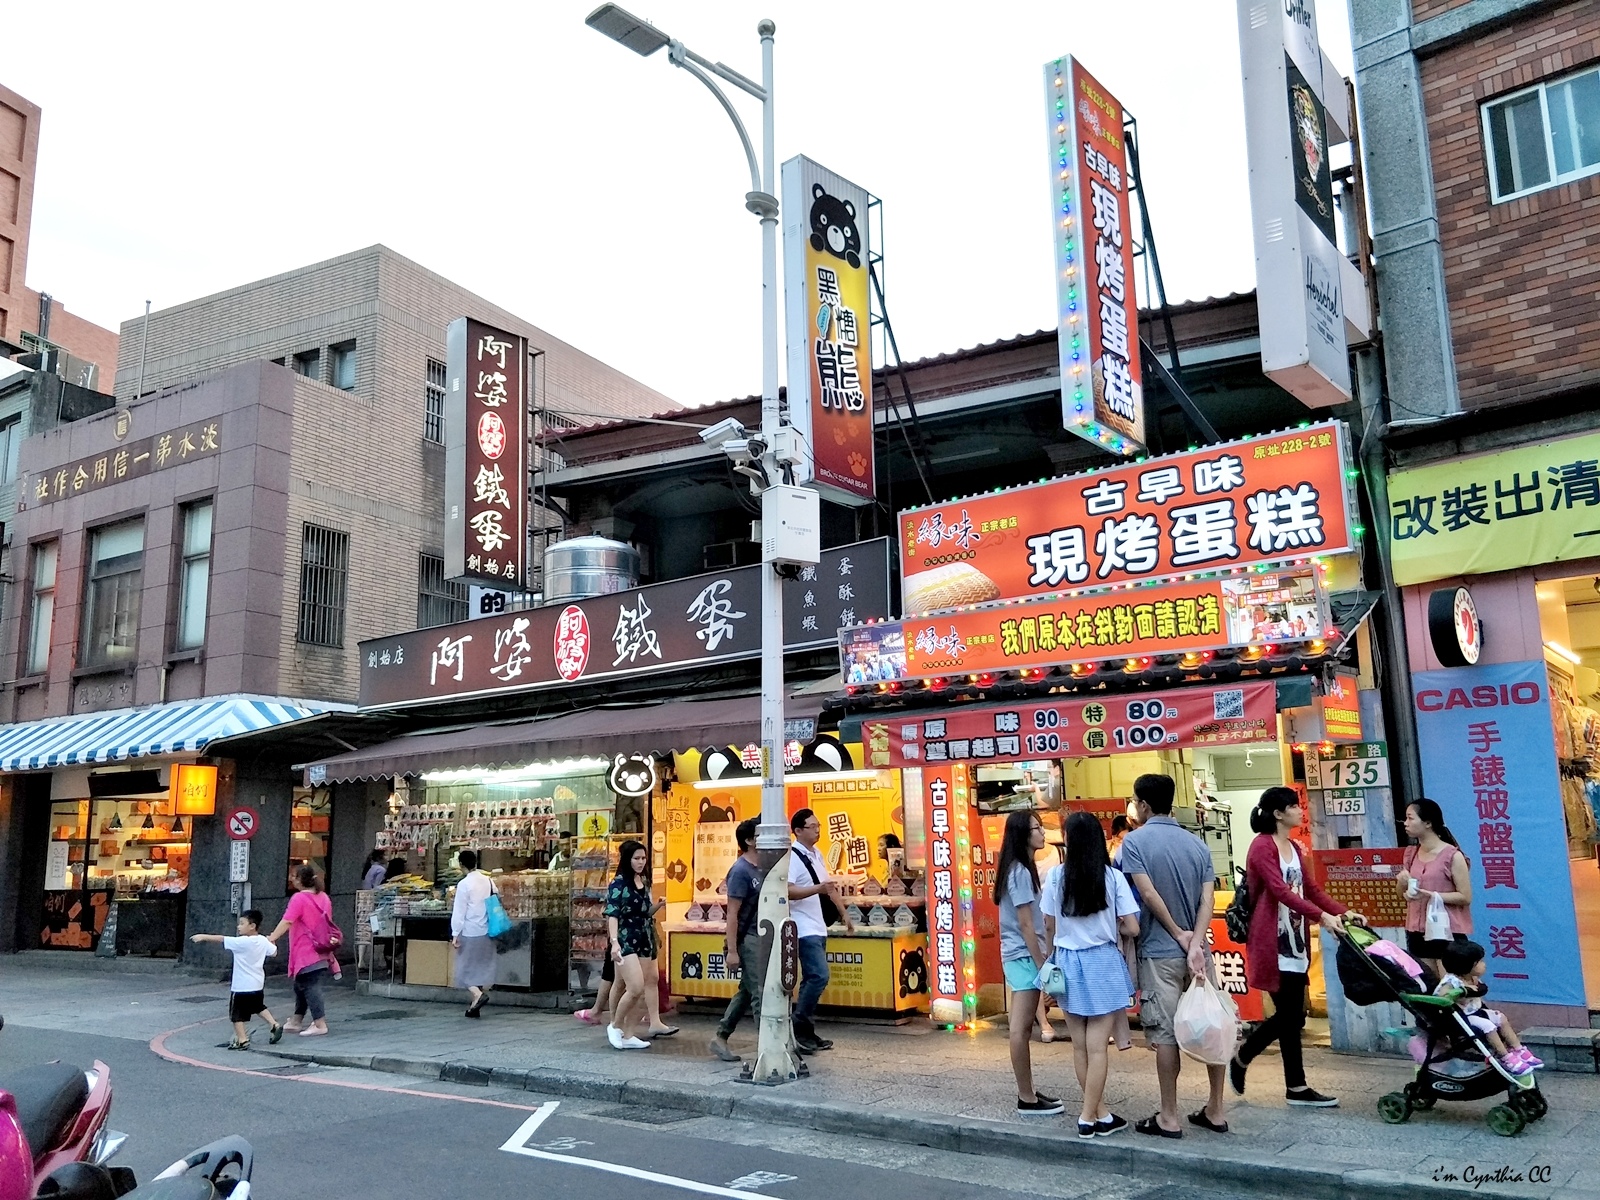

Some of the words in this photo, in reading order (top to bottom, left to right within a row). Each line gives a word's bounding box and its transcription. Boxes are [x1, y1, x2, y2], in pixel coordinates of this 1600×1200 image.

[1083, 140, 1123, 193] 古早味
[1089, 175, 1135, 424] 現烤蛋糕
[1253, 432, 1333, 460] 原址228-2號
[854, 479, 869, 490] BEAR
[1082, 455, 1246, 517] 古早味
[1392, 459, 1600, 541] 改裝出清
[906, 520, 916, 557] 淡水老街
[980, 516, 1018, 533] 正宗老店
[1026, 484, 1325, 587] 現烤蛋糕
[467, 553, 517, 580] 創始店
[430, 616, 533, 687] 阿婆
[612, 578, 748, 667] 鐵蛋
[965, 635, 996, 646] 正宗老店
[1000, 593, 1221, 656] 我們原本在斜對面請認清
[367, 644, 405, 669] 創始店
[1416, 680, 1541, 713] CASIO
[869, 722, 891, 766] 大特價
[1084, 705, 1107, 750] 特價
[1192, 729, 1269, 743] 加盒子不加價
[924, 735, 1020, 762] 雙層起司
[1322, 743, 1382, 760] 中正路
[1306, 750, 1319, 787] 淡水區
[1329, 760, 1379, 786] 135
[1333, 789, 1364, 798] 中正路
[1337, 799, 1361, 812] 135
[1353, 854, 1383, 864] 公告
[1466, 720, 1530, 981] 手錶破盤買一送一
[930, 776, 957, 995] 古早味現烤蛋糕
[784, 925, 794, 986] 淡水老街
